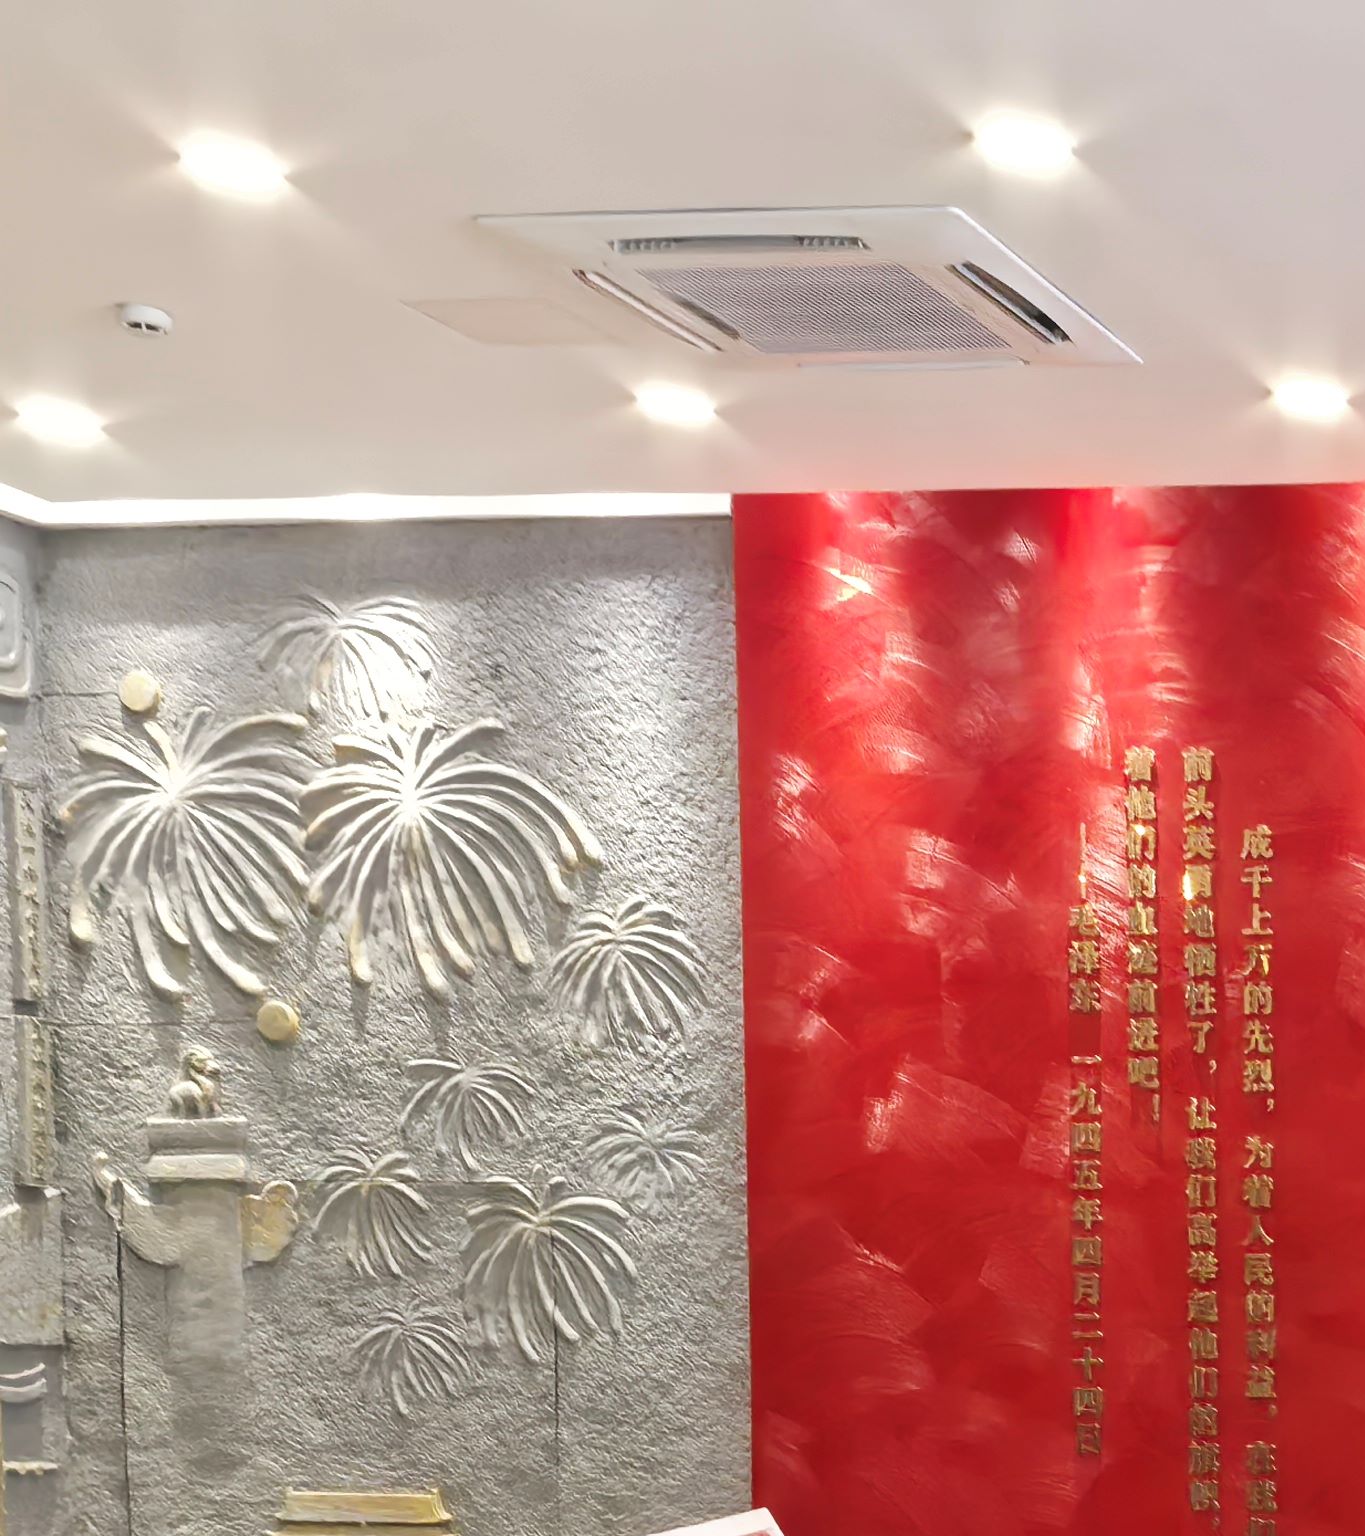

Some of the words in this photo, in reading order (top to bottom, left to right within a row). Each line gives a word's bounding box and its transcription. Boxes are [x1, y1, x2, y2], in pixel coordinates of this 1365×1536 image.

[1069, 1055, 1104, 1456] 一九四五年四月二十四日
